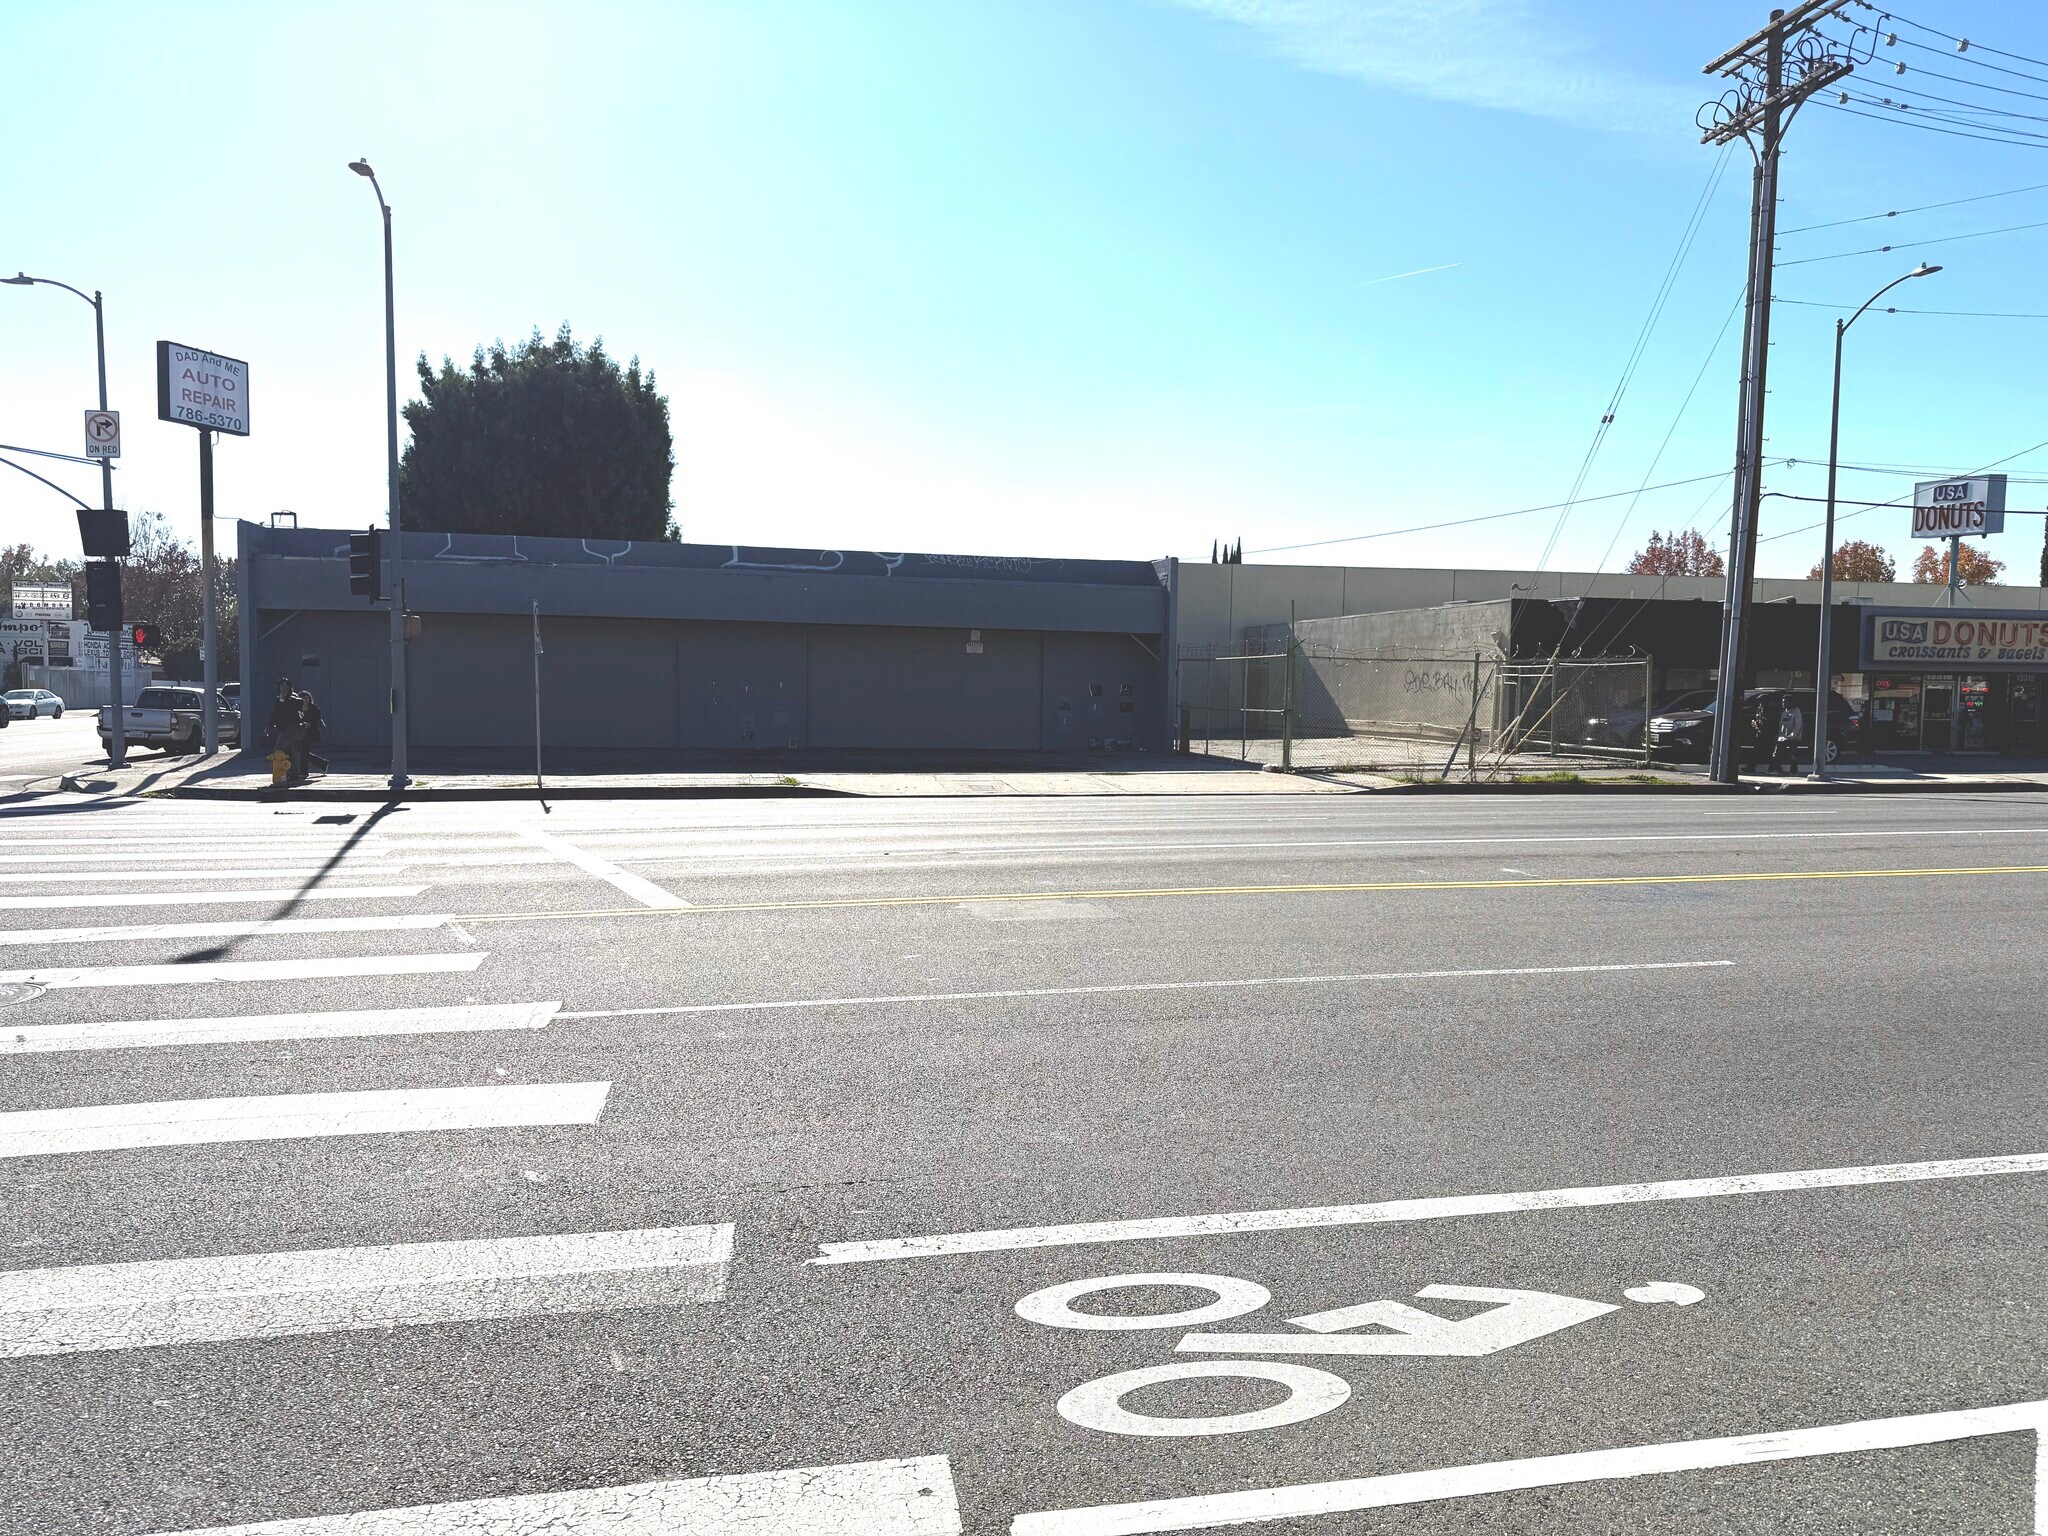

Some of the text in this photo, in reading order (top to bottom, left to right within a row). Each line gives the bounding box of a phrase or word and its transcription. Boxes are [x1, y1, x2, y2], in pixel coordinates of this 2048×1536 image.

[176, 351, 240, 377] DAD And ME
[182, 368, 236, 391] AUTO
[182, 388, 236, 412] REPAIR
[176, 405, 242, 430] 786-5370
[89, 445, 118, 454] ON RED
[1936, 485, 1965, 500] USA
[1914, 501, 1985, 532] DONUTS
[1885, 622, 1924, 641] USA
[1978, 647, 1991, 659] &
